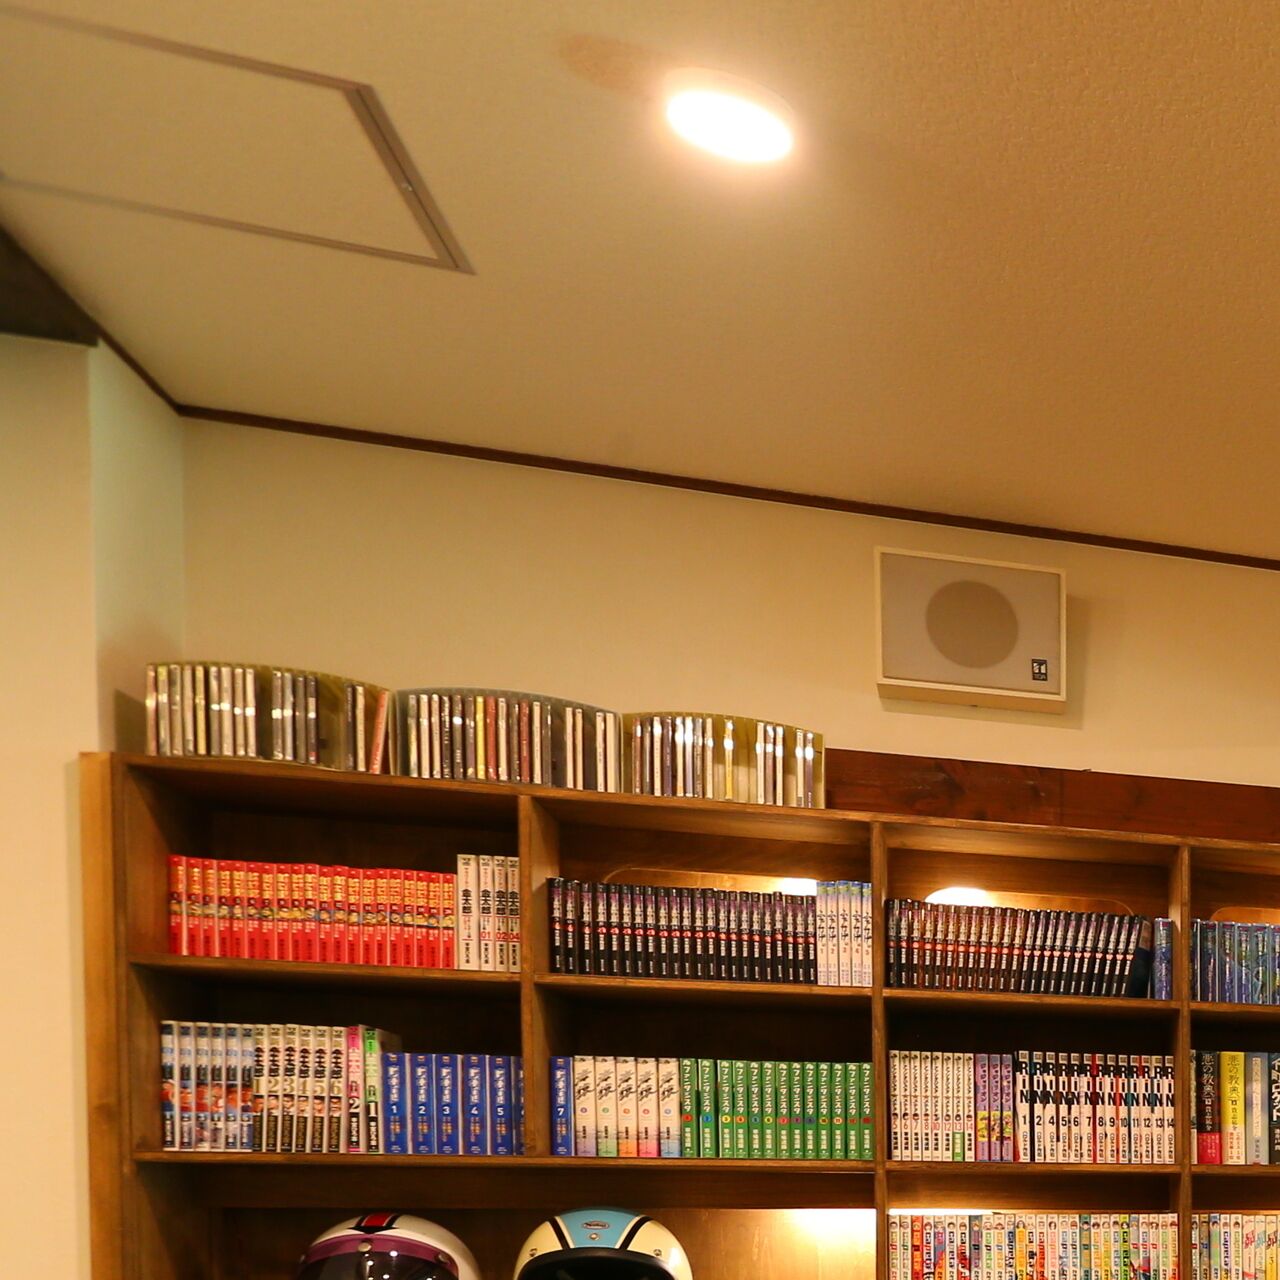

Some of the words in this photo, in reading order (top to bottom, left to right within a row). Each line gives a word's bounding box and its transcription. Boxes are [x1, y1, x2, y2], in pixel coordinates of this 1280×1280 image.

[1202, 1054, 1214, 1097] 悪の教典
[253, 1079, 260, 1093] 1
[268, 1080, 280, 1093] 2
[284, 1079, 294, 1093] 3
[299, 1080, 308, 1094] 4
[314, 1080, 324, 1095] 5
[331, 1081, 341, 1095] 6
[558, 1108, 564, 1116] 7
[1022, 1116, 1026, 1126] 1
[1036, 1116, 1042, 1126] 2
[1049, 1116, 1055, 1126] 4
[1061, 1116, 1067, 1126] 5
[1073, 1116, 1079, 1126] 6
[1086, 1116, 1092, 1127] 7
[1098, 1116, 1104, 1127] 8
[1109, 1116, 1115, 1127] 9
[1120, 1117, 1128, 1127] 10
[1132, 1118, 1139, 1127] 11
[1143, 1118, 1150, 1127] 12
[1155, 1118, 1163, 1128] 13
[1166, 1118, 1174, 1128] 14
